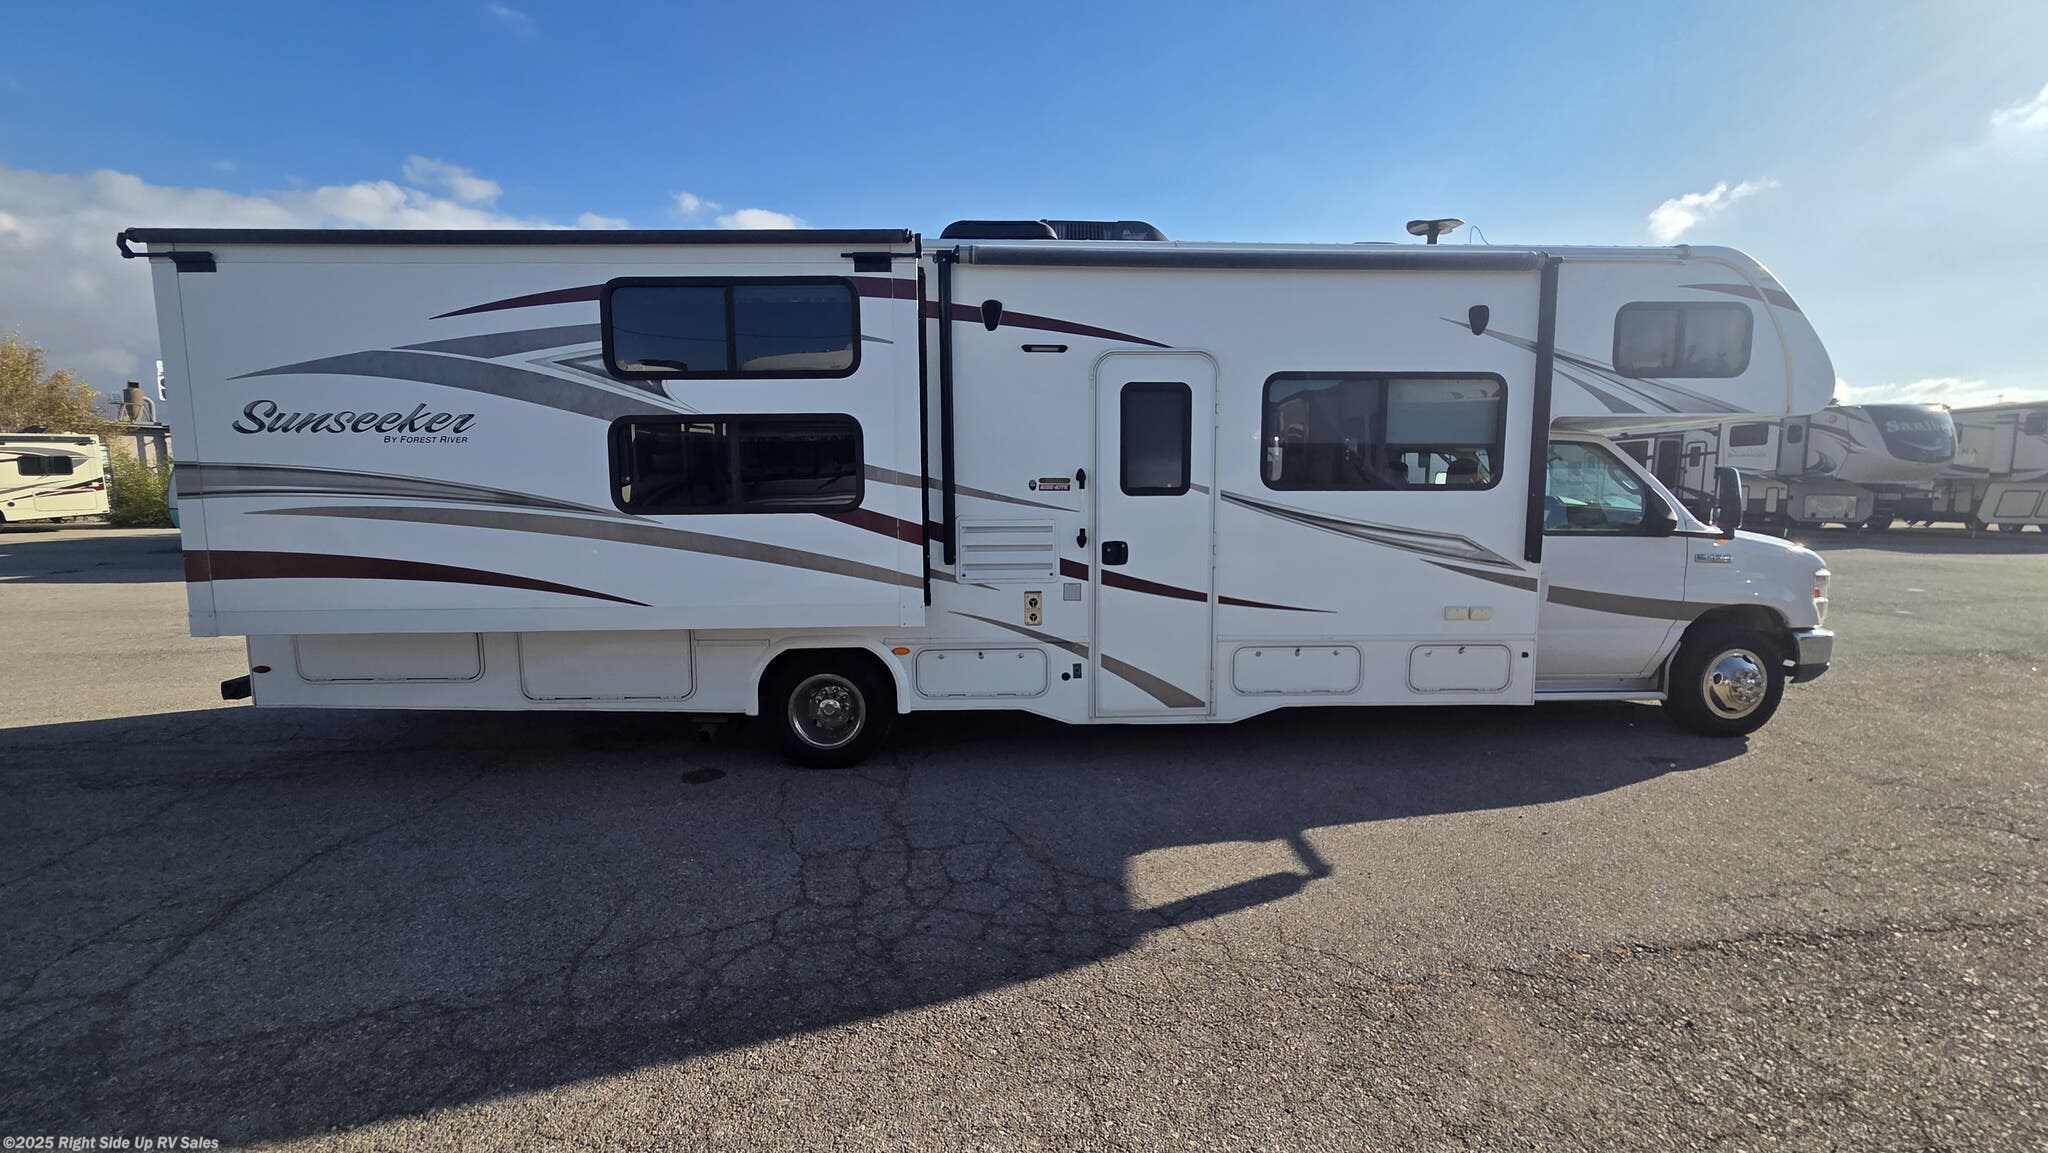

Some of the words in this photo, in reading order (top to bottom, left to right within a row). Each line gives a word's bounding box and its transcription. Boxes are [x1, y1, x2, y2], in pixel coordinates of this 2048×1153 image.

[232, 400, 476, 434] Sunseeker
[384, 436, 398, 444] BY
[400, 436, 437, 444] FOREST
[440, 436, 468, 444] RIVER
